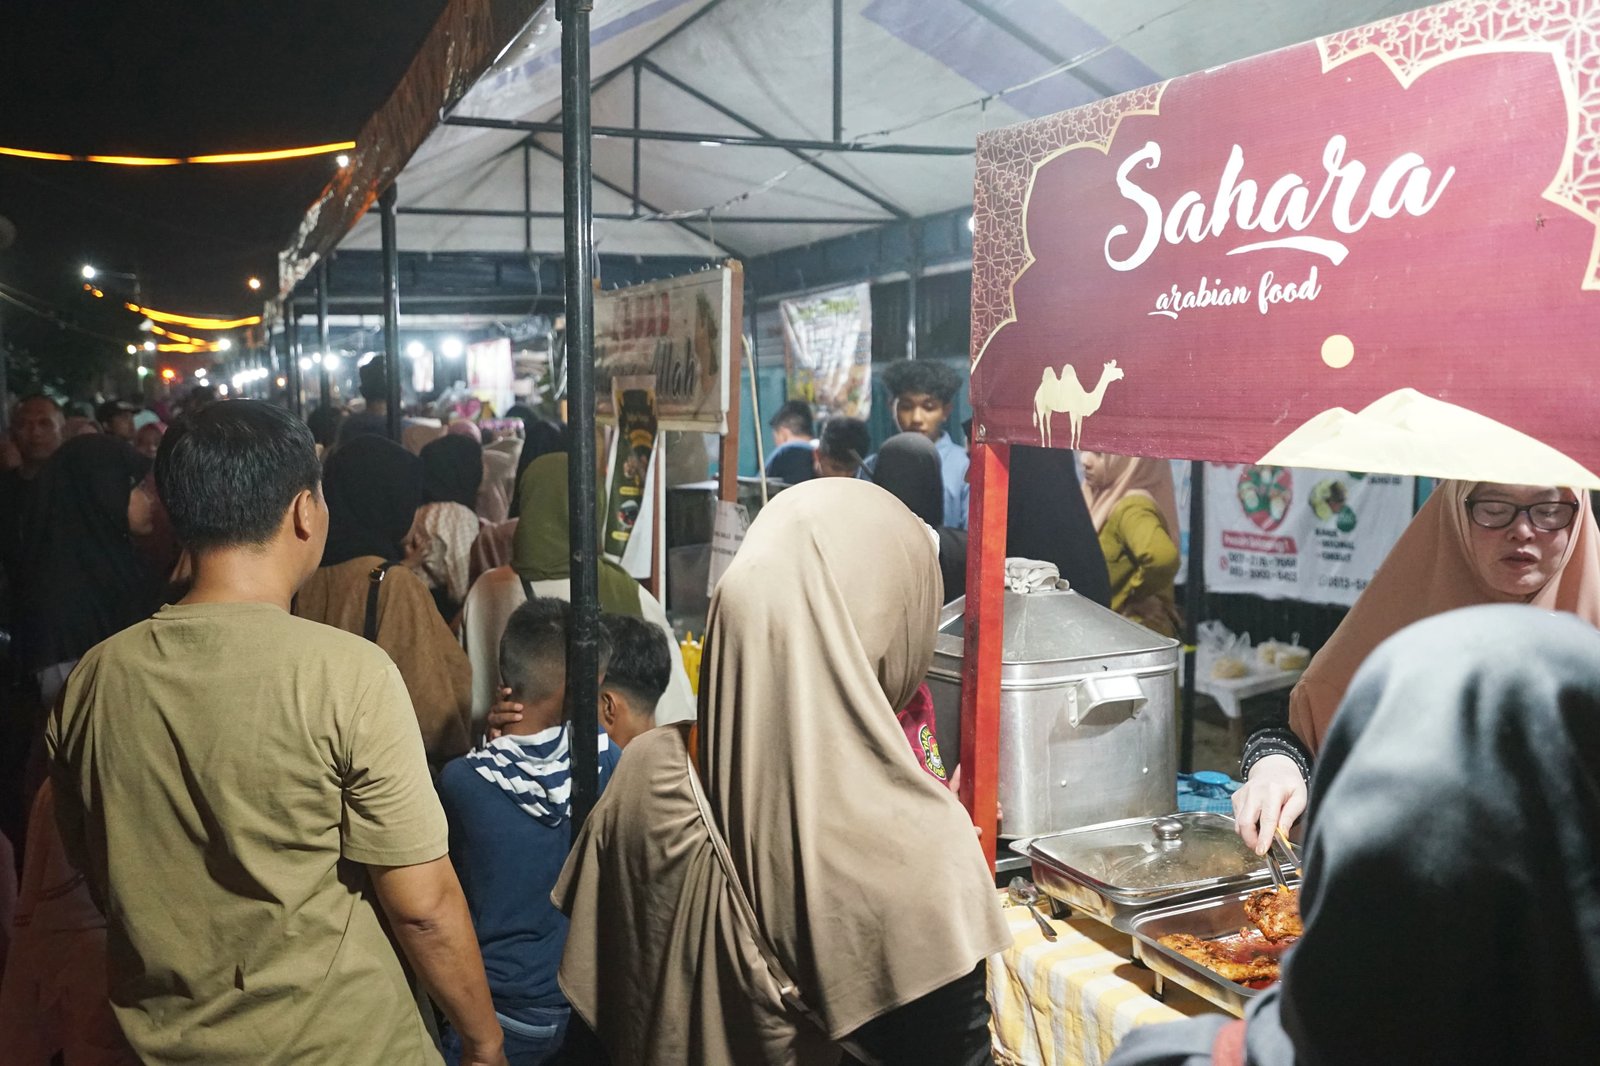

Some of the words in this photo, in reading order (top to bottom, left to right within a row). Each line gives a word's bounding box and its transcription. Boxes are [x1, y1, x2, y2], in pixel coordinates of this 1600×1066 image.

[1104, 134, 1455, 272] Sahara
[1149, 276, 1251, 319] arabian
[1258, 265, 1322, 315] food
